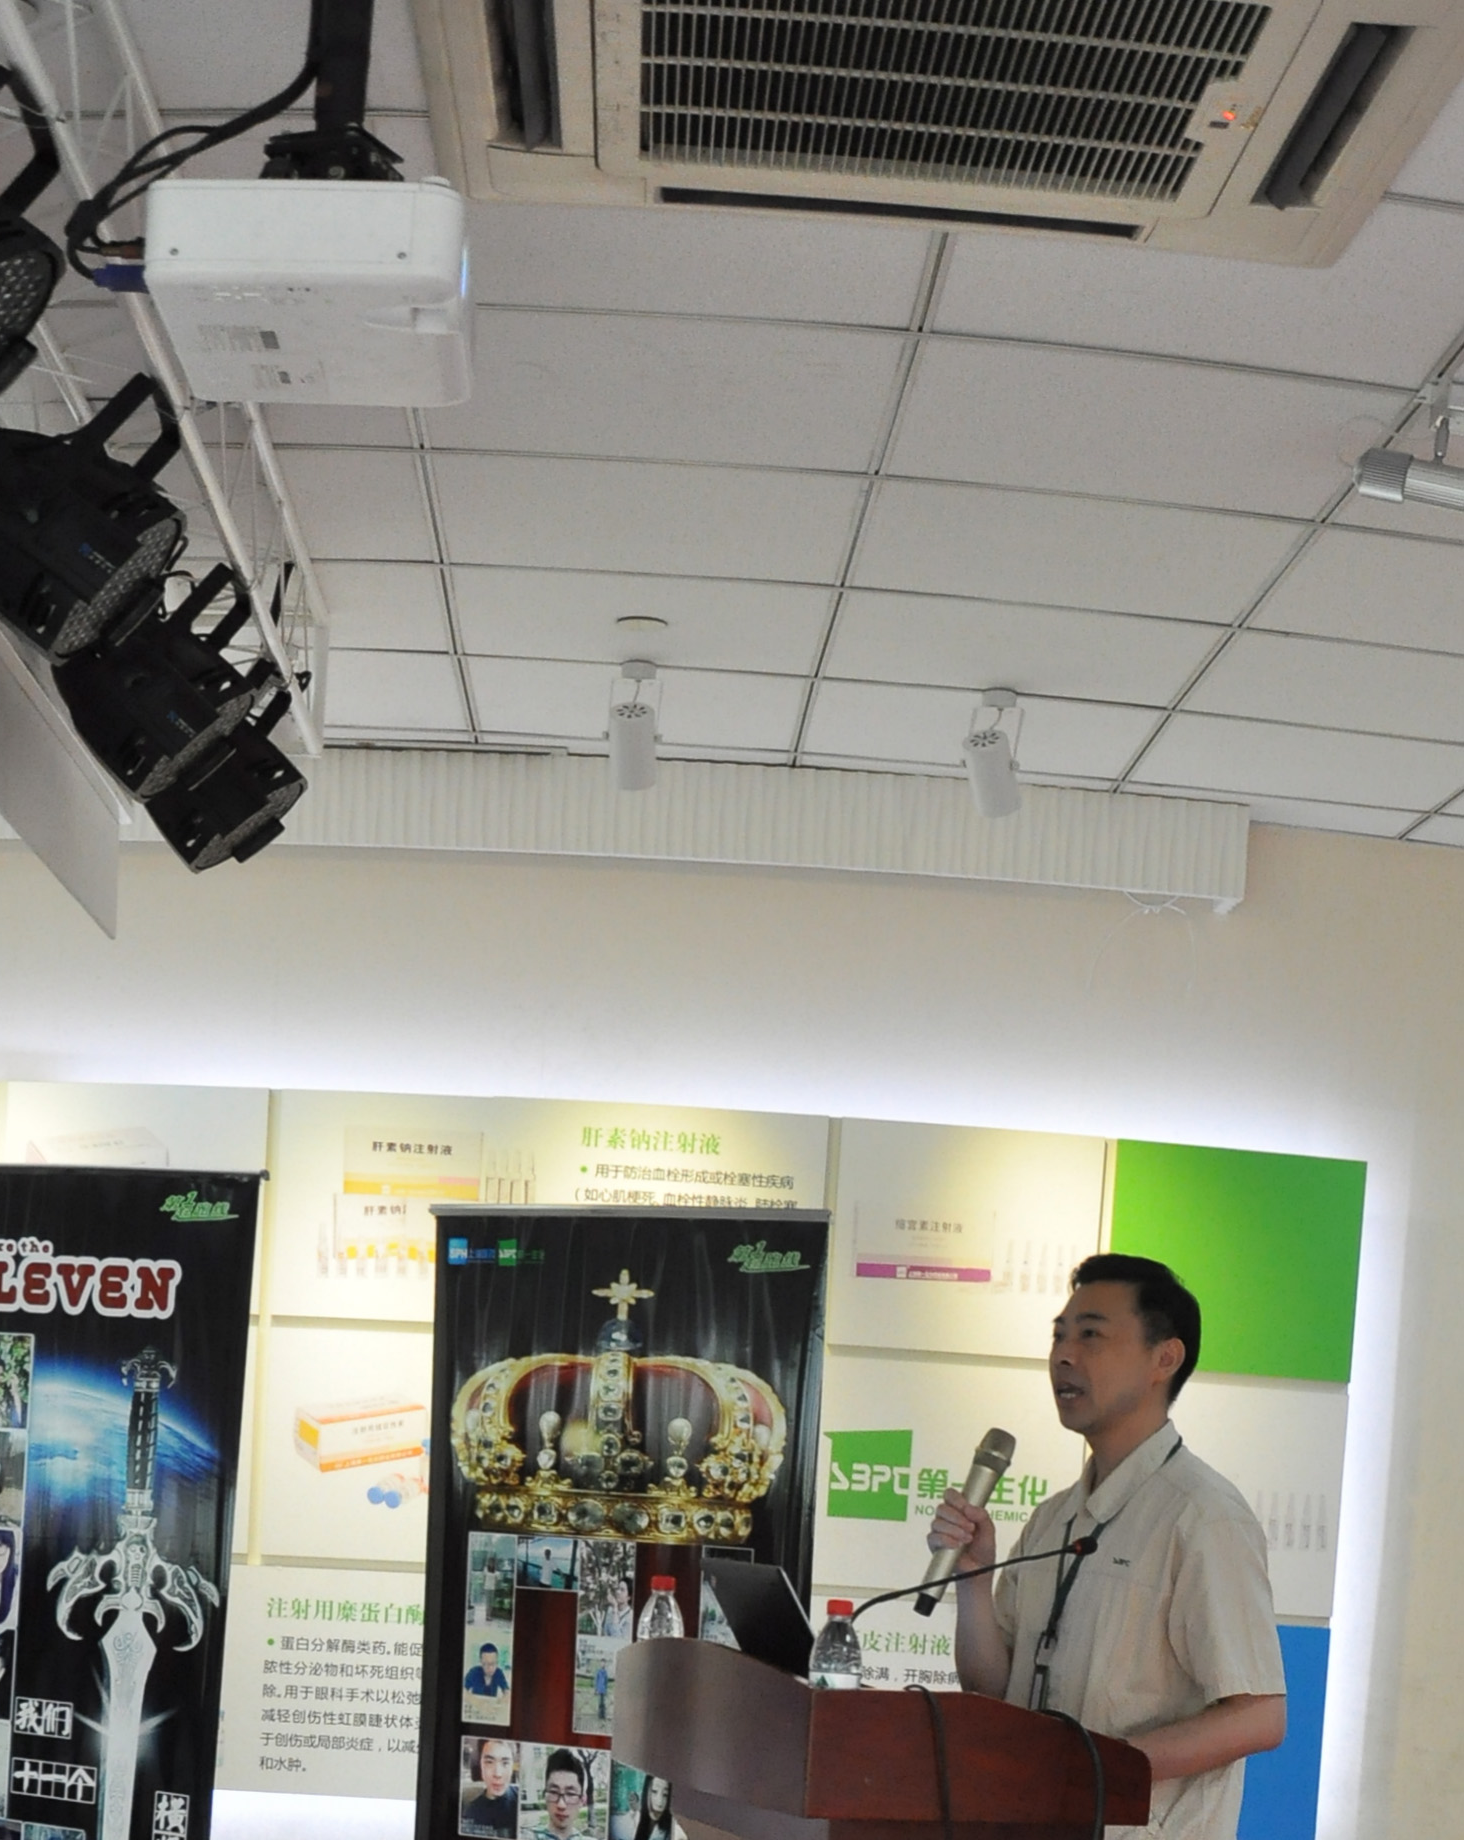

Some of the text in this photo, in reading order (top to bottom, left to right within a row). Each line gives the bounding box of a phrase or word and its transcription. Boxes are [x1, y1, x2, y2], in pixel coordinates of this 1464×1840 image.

[371, 1141, 454, 1157] 肝素钠注射液
[581, 1127, 721, 1155] 肝素钠注射液
[20, 1238, 51, 1255] the
[855, 1630, 952, 1657] 皮注射液
[16, 1701, 73, 1737] 我们
[259, 1756, 308, 1773] 和水肿。
[13, 1761, 96, 1801] 十一个
